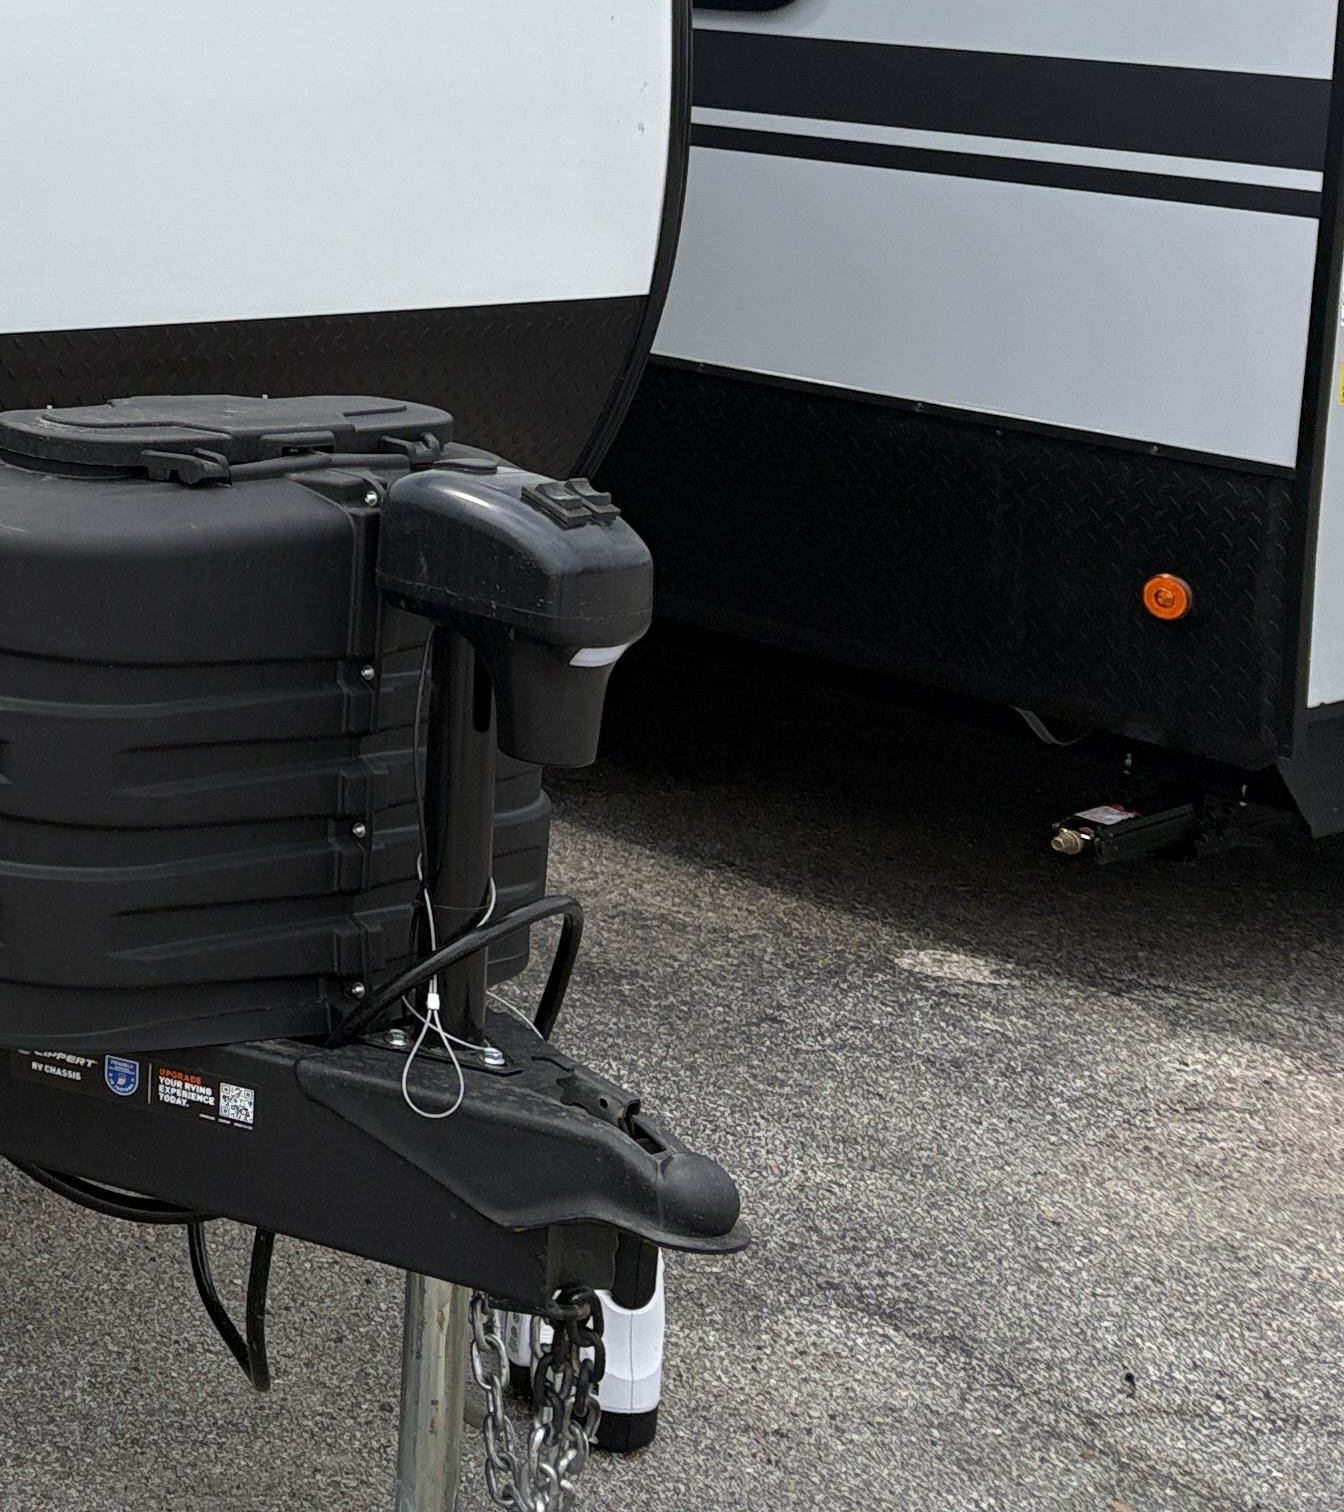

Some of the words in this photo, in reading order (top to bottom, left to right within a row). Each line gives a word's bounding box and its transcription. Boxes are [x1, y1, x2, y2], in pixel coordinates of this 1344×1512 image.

[31, 1061, 43, 1072] RV
[44, 1065, 82, 1081] CHASSIS
[159, 1068, 202, 1085] UPGRADE
[158, 1075, 183, 1090] YOUR
[184, 1081, 213, 1096] RVING
[158, 1084, 216, 1106] EXPERIENCE
